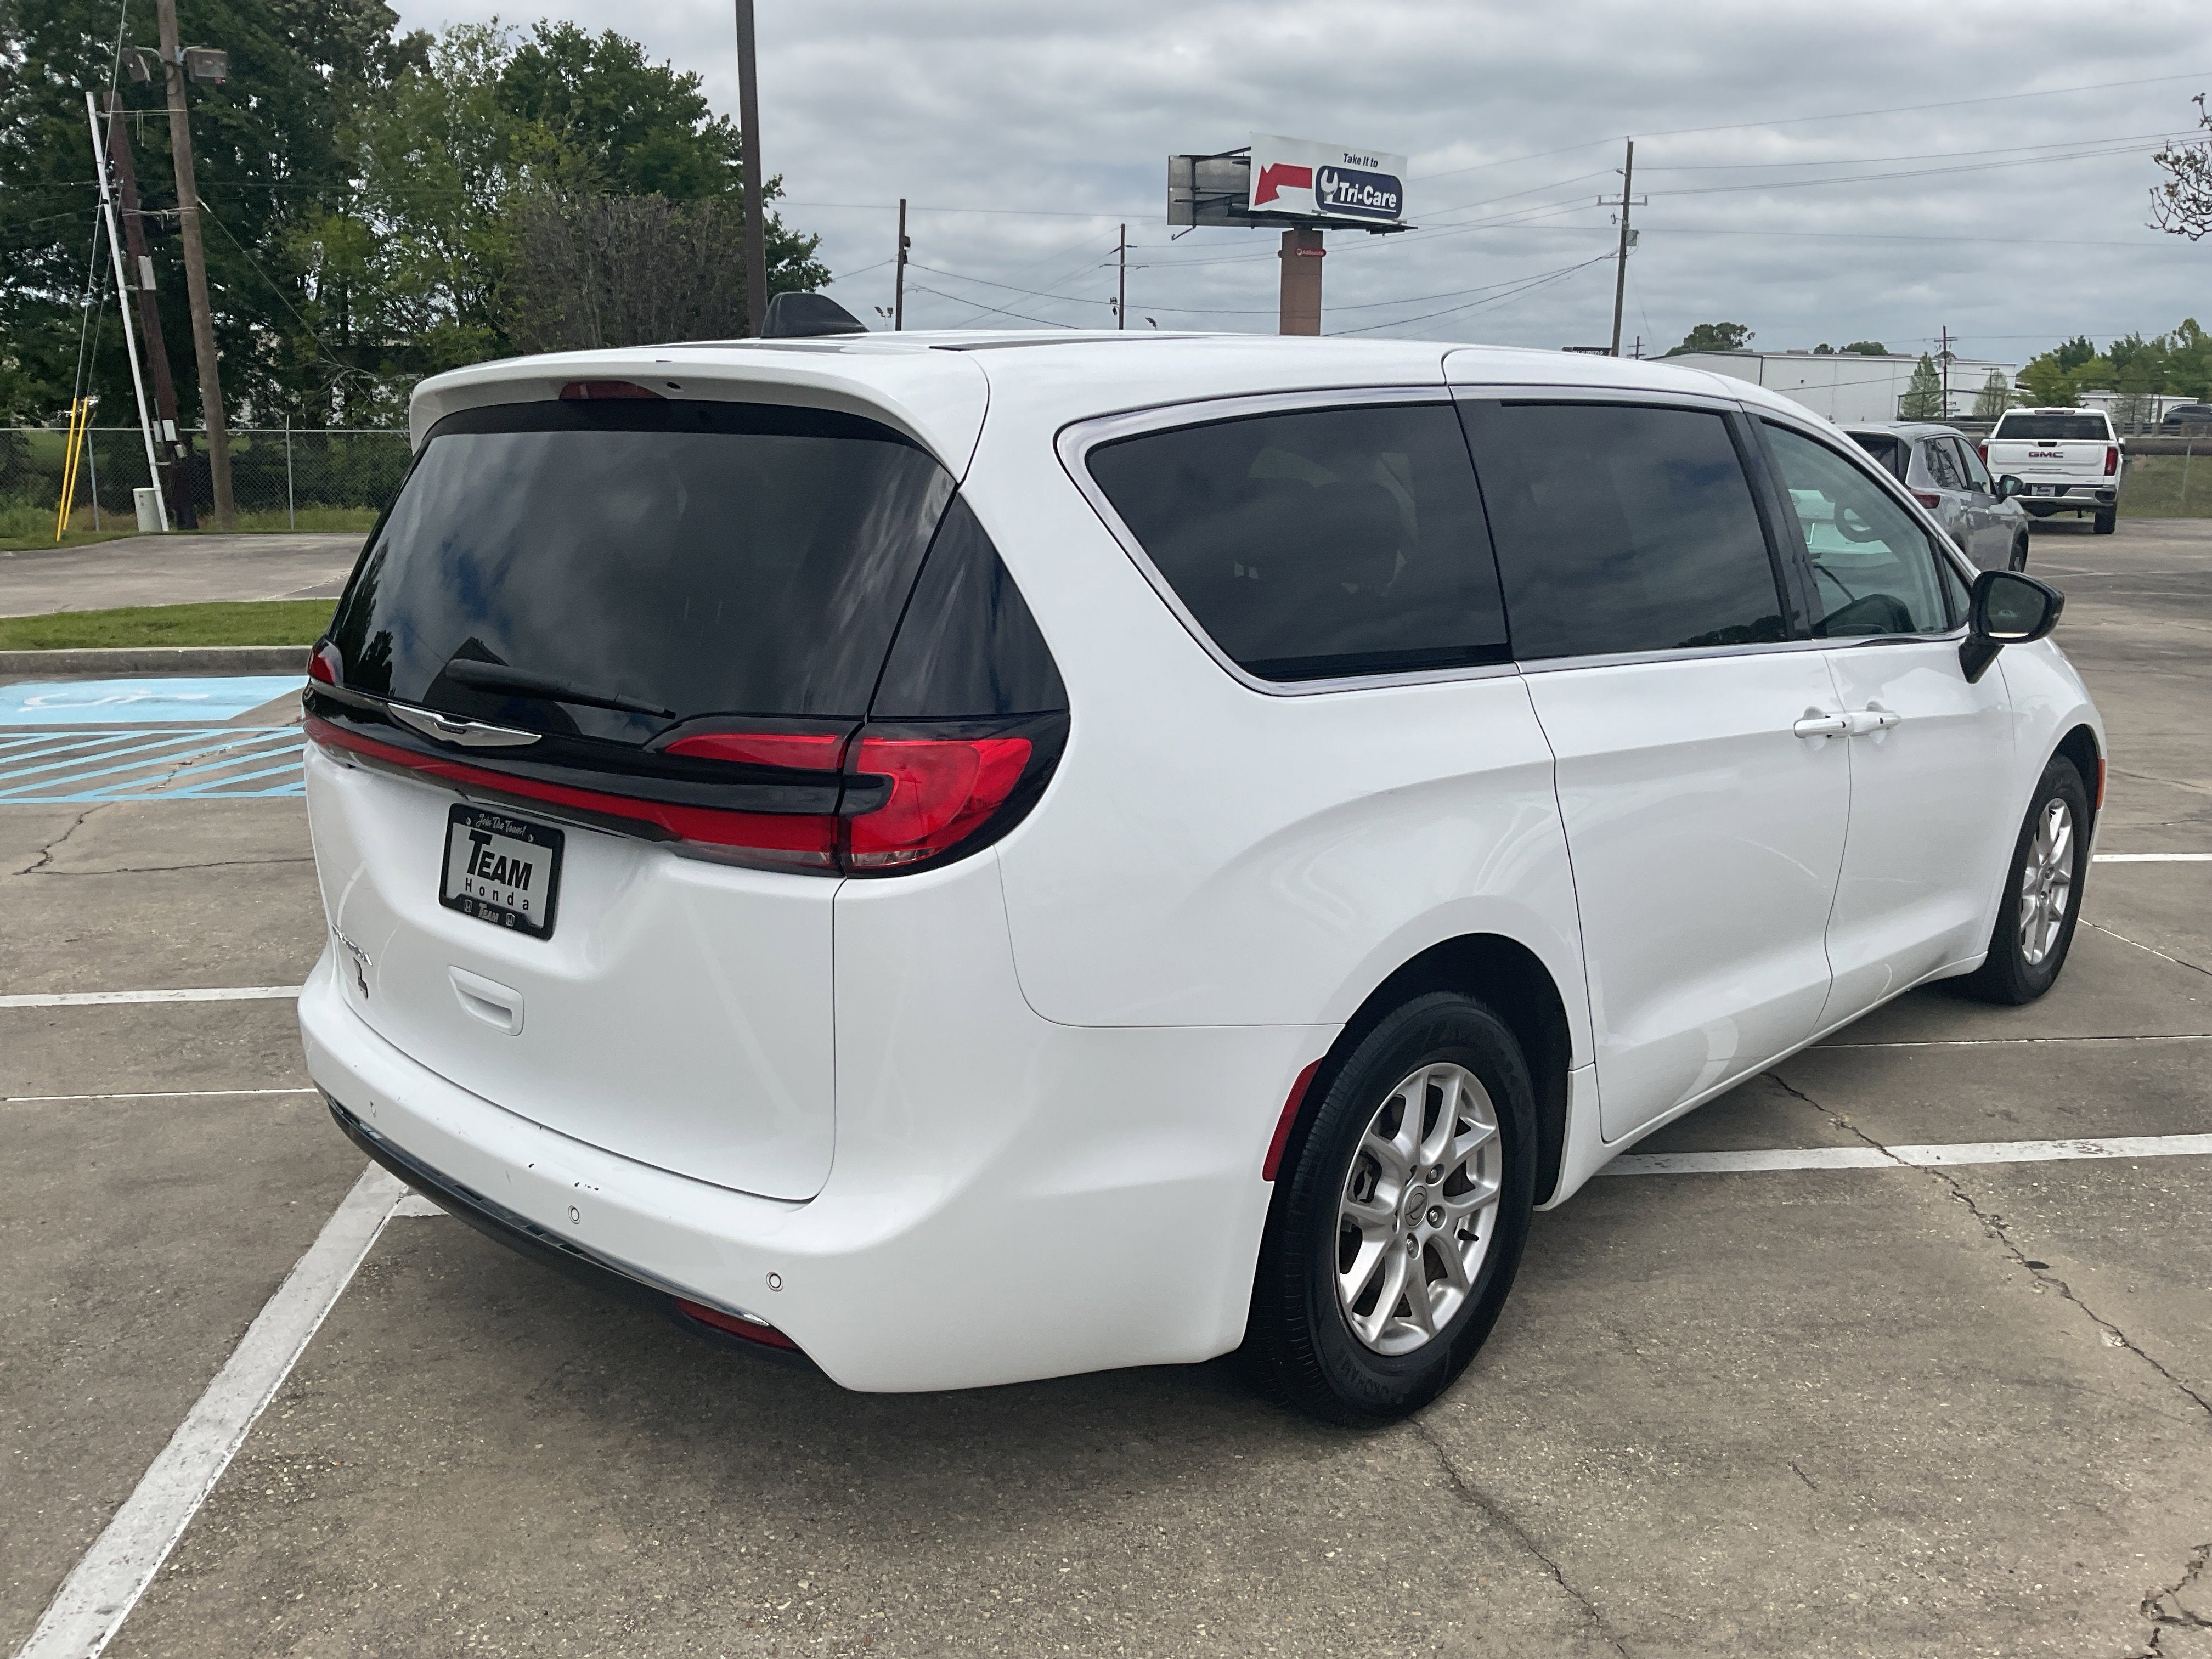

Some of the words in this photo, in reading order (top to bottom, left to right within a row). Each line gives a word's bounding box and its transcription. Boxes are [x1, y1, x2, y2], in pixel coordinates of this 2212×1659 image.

[1344, 153, 1362, 165] Take
[1363, 156, 1369, 166] It
[1372, 157, 1379, 168] to
[1339, 182, 1397, 208] Tri-Care
[476, 814, 492, 828] Join
[493, 817, 505, 830] The
[505, 820, 527, 836] Team!
[467, 829, 533, 891] TEAM
[465, 877, 529, 911] Honda
[478, 902, 499, 923] TEAM
